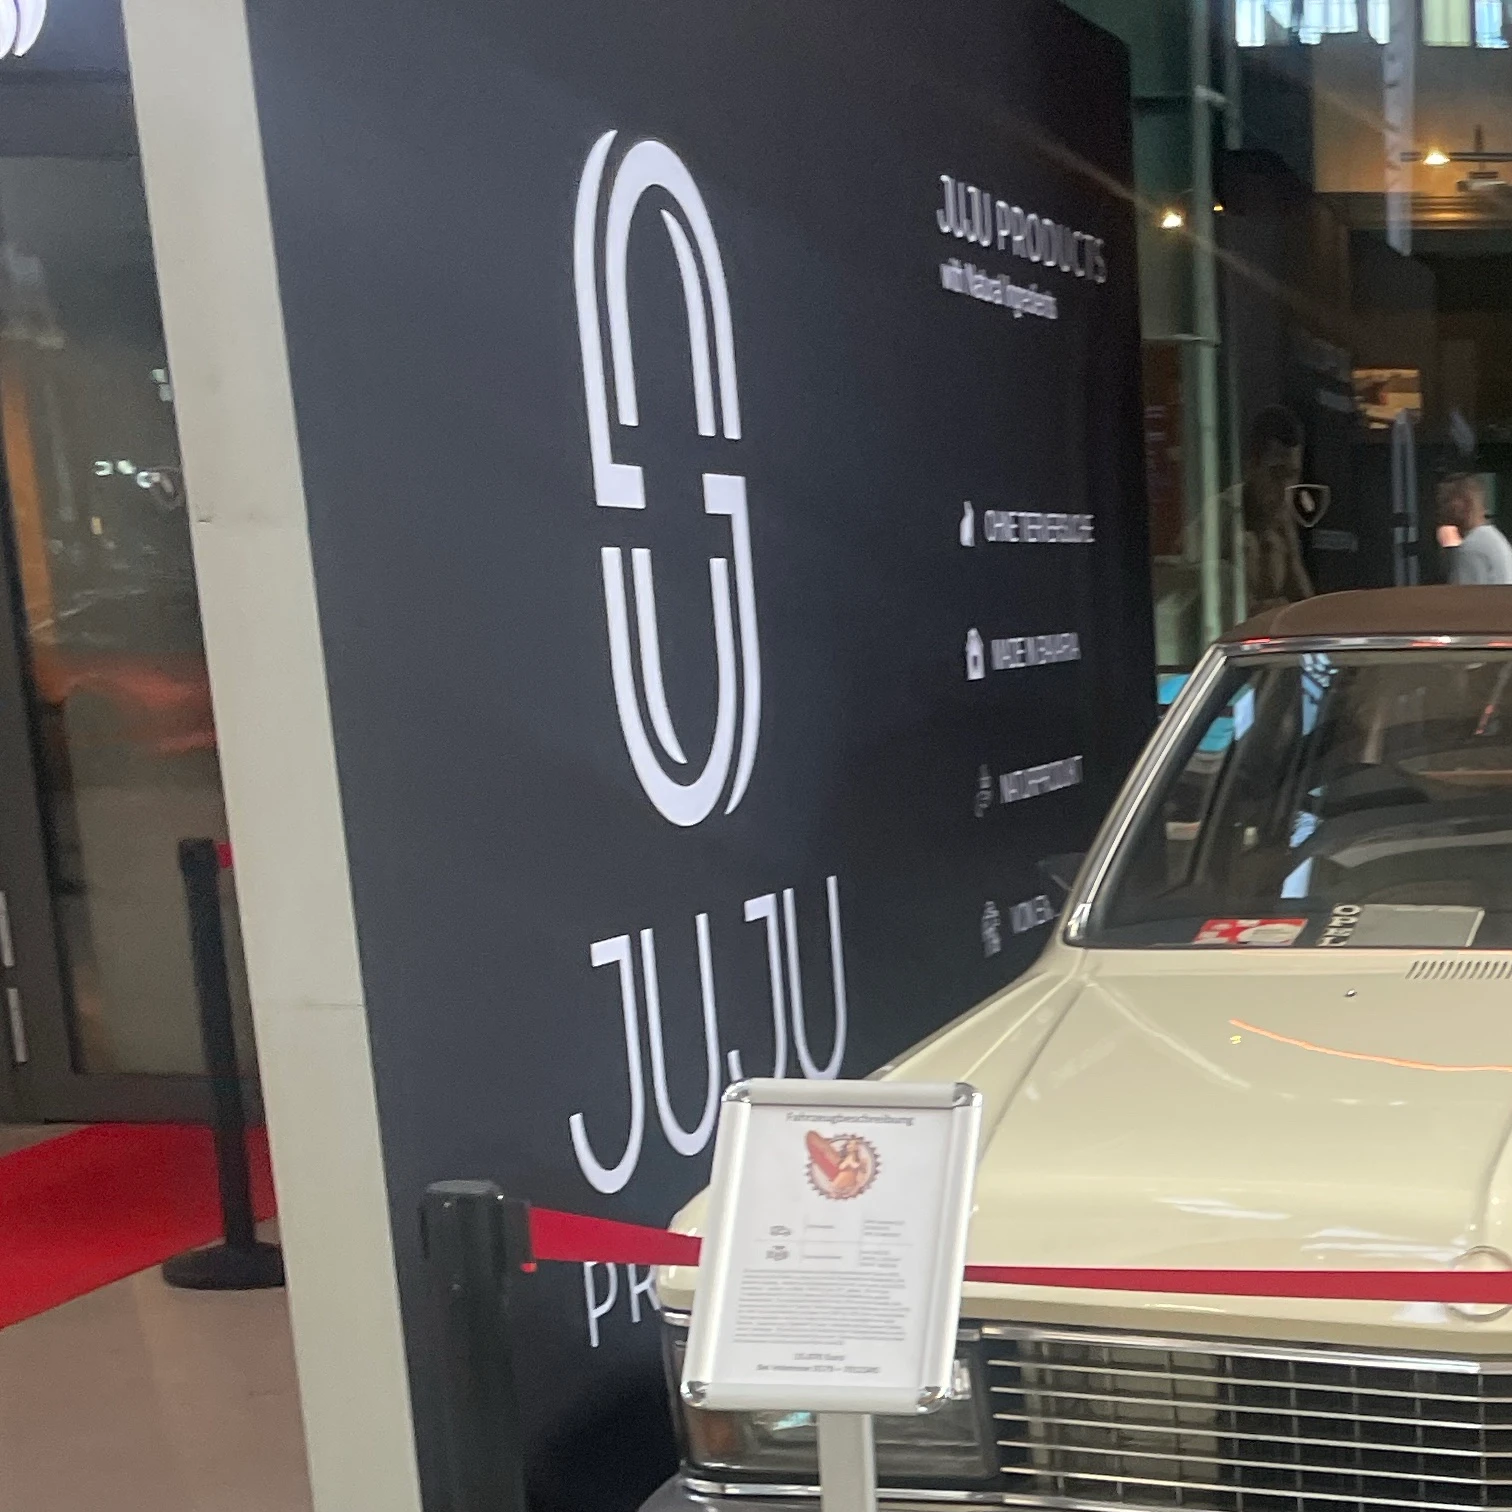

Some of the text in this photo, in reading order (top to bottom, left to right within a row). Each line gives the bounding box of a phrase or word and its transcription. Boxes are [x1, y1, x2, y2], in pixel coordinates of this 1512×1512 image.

[936, 174, 1107, 283] JUJU PRODUCTS
[1317, 903, 1361, 947] OPEL
[569, 876, 847, 1194] JUJU
